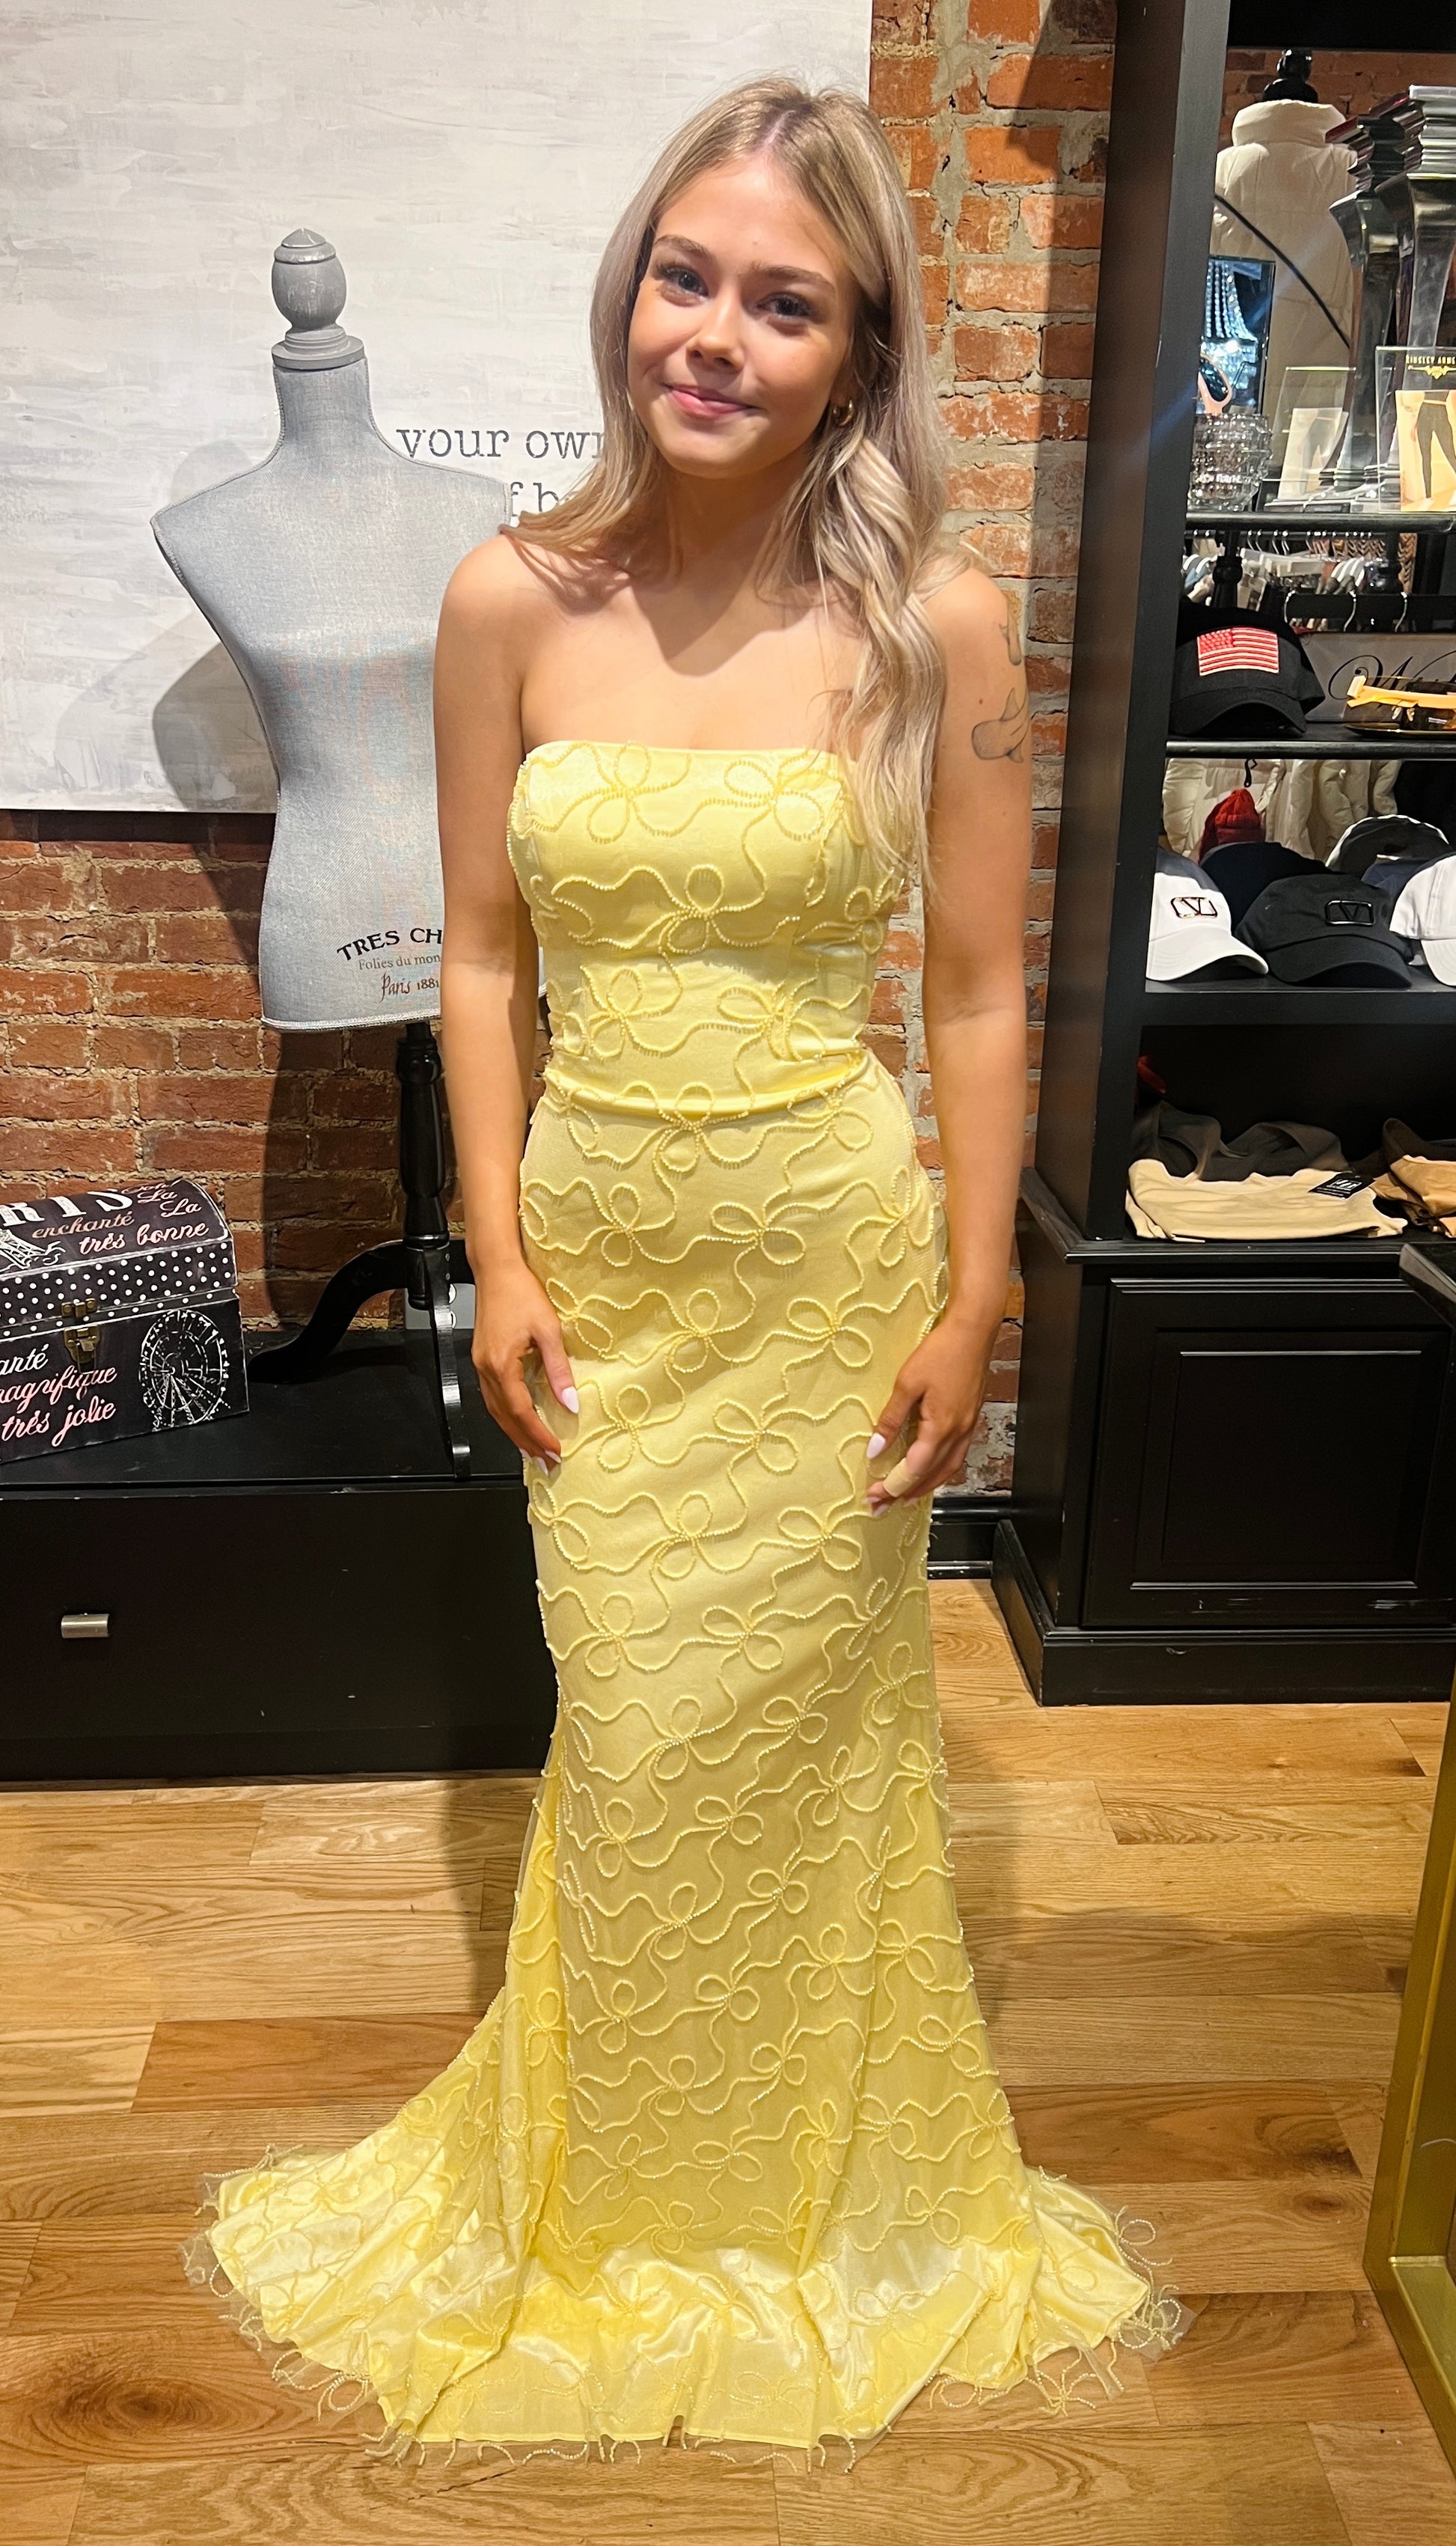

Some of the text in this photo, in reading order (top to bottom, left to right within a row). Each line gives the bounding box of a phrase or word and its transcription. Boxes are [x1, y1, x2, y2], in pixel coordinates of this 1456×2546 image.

[396, 428, 510, 458] your
[337, 928, 443, 961] TRES CH
[358, 953, 441, 971] Folies du mon
[379, 973, 441, 1003] Paris 1881
[0, 1188, 133, 1227] RIS
[137, 1189, 178, 1204] La
[159, 1198, 202, 1218] La
[32, 1211, 135, 1239] enchanté
[137, 1223, 209, 1245] bonne
[0, 1343, 49, 1376] anté
[0, 1364, 117, 1414] agnifique
[52, 1395, 117, 1447] jolie
